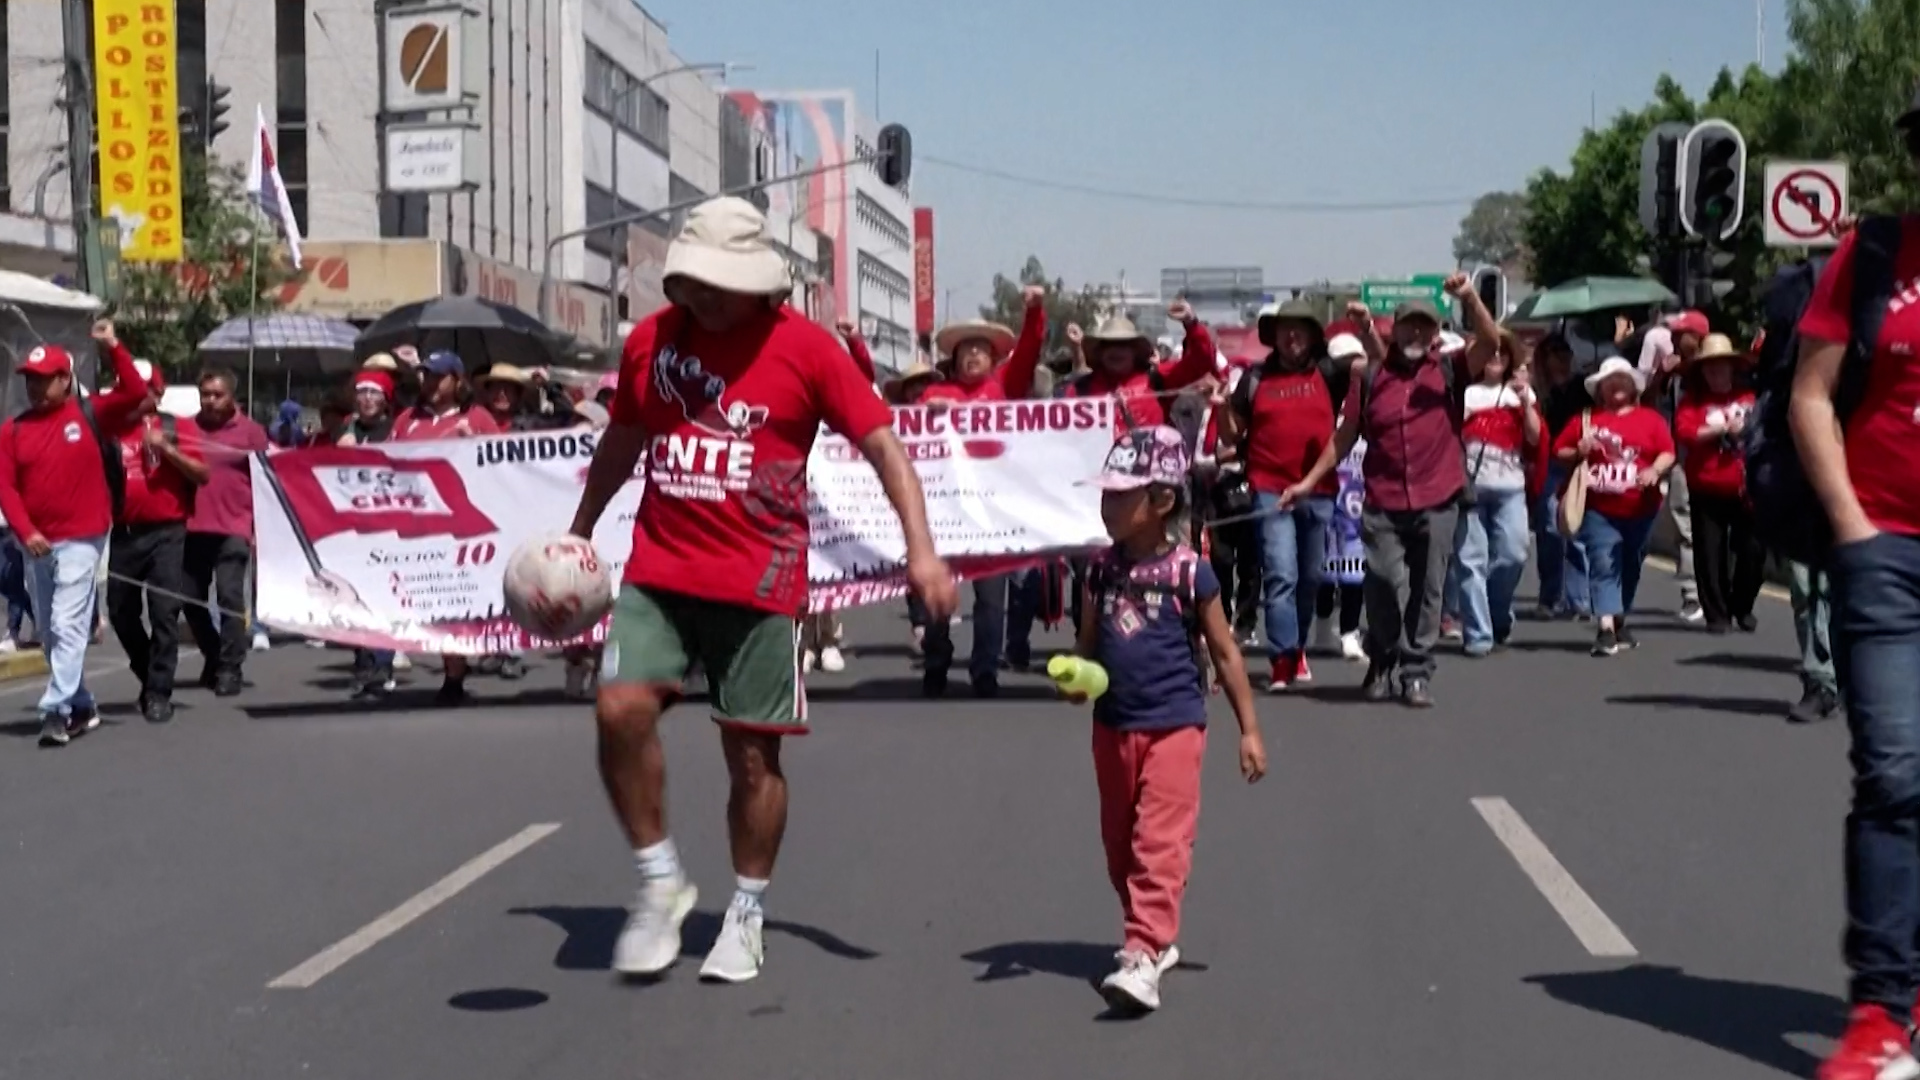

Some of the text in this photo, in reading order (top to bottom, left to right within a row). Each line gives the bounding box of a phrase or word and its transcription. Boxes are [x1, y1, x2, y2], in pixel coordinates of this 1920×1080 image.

[105, 13, 136, 194] POLLOS
[140, 4, 173, 247] ROSTIZADOS
[477, 433, 595, 466] ¡UNIDOS
[891, 401, 1109, 438] NCEREMOS!
[652, 433, 755, 480] CNTE
[455, 540, 497, 567] 10
